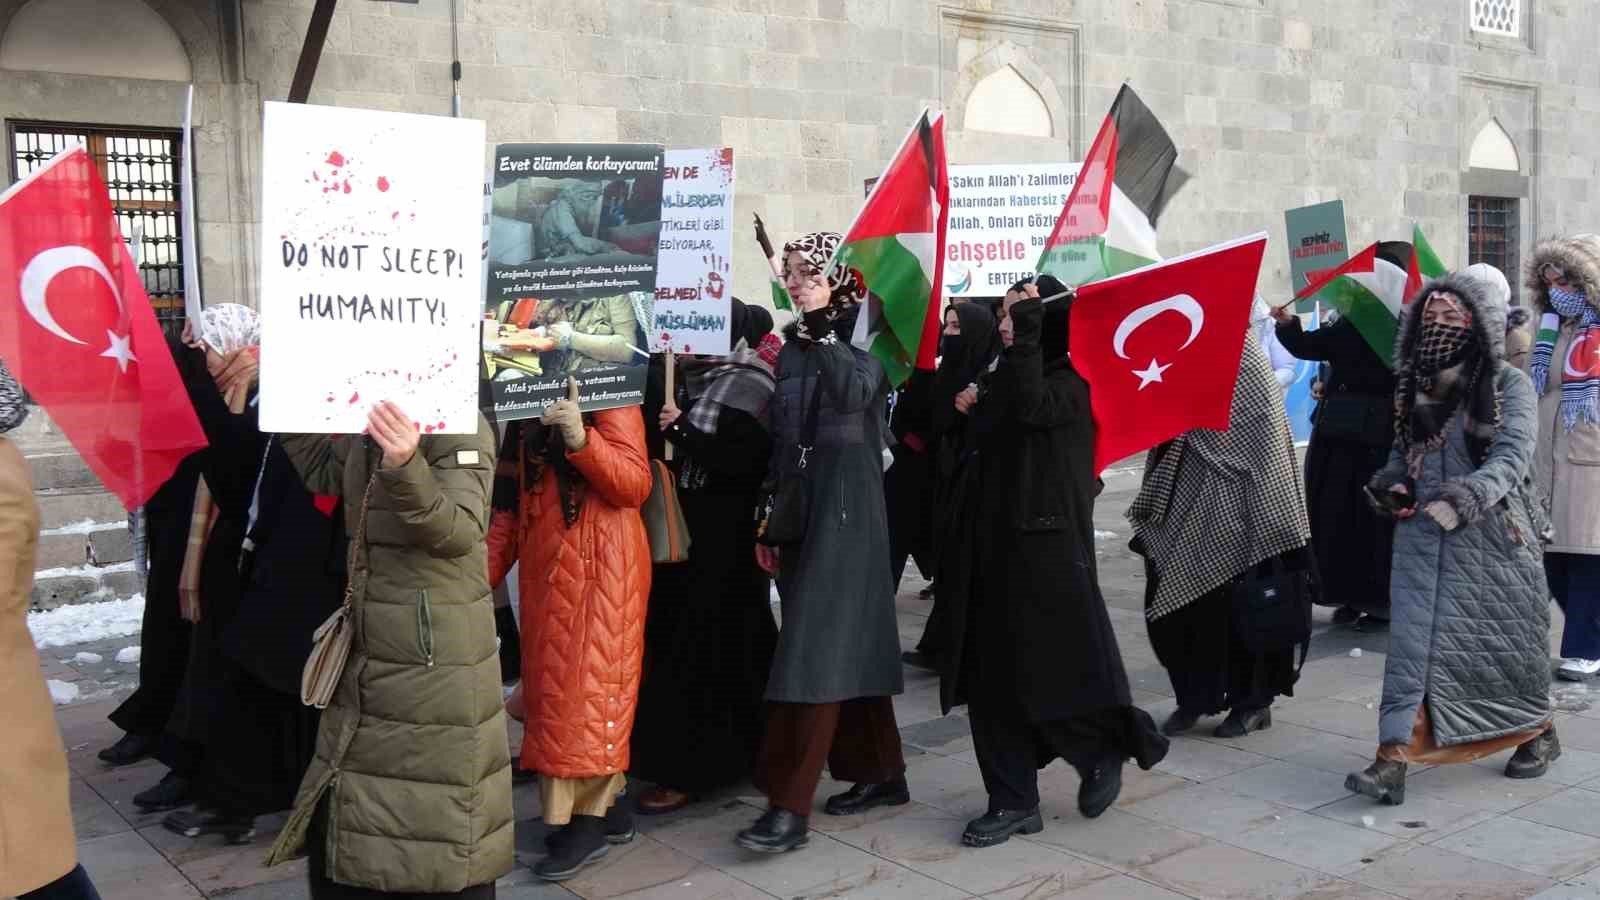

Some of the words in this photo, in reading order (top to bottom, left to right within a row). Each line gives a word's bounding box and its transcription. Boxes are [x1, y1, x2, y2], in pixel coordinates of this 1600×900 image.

[500, 156, 529, 171] Evet
[533, 155, 583, 171] ölümden
[586, 155, 659, 174] korkuyorum!
[683, 166, 699, 179] DE
[1009, 193, 1058, 207] Habersiz
[988, 216, 1024, 228] Onları
[282, 240, 308, 268] DO
[321, 245, 369, 271] NOT
[381, 246, 463, 278] SLEEP!
[948, 240, 1025, 267] ehşetle
[299, 293, 446, 326] HUMANITY!
[655, 310, 726, 331] MÜSLÜMAN
[528, 379, 560, 393] yolunda
